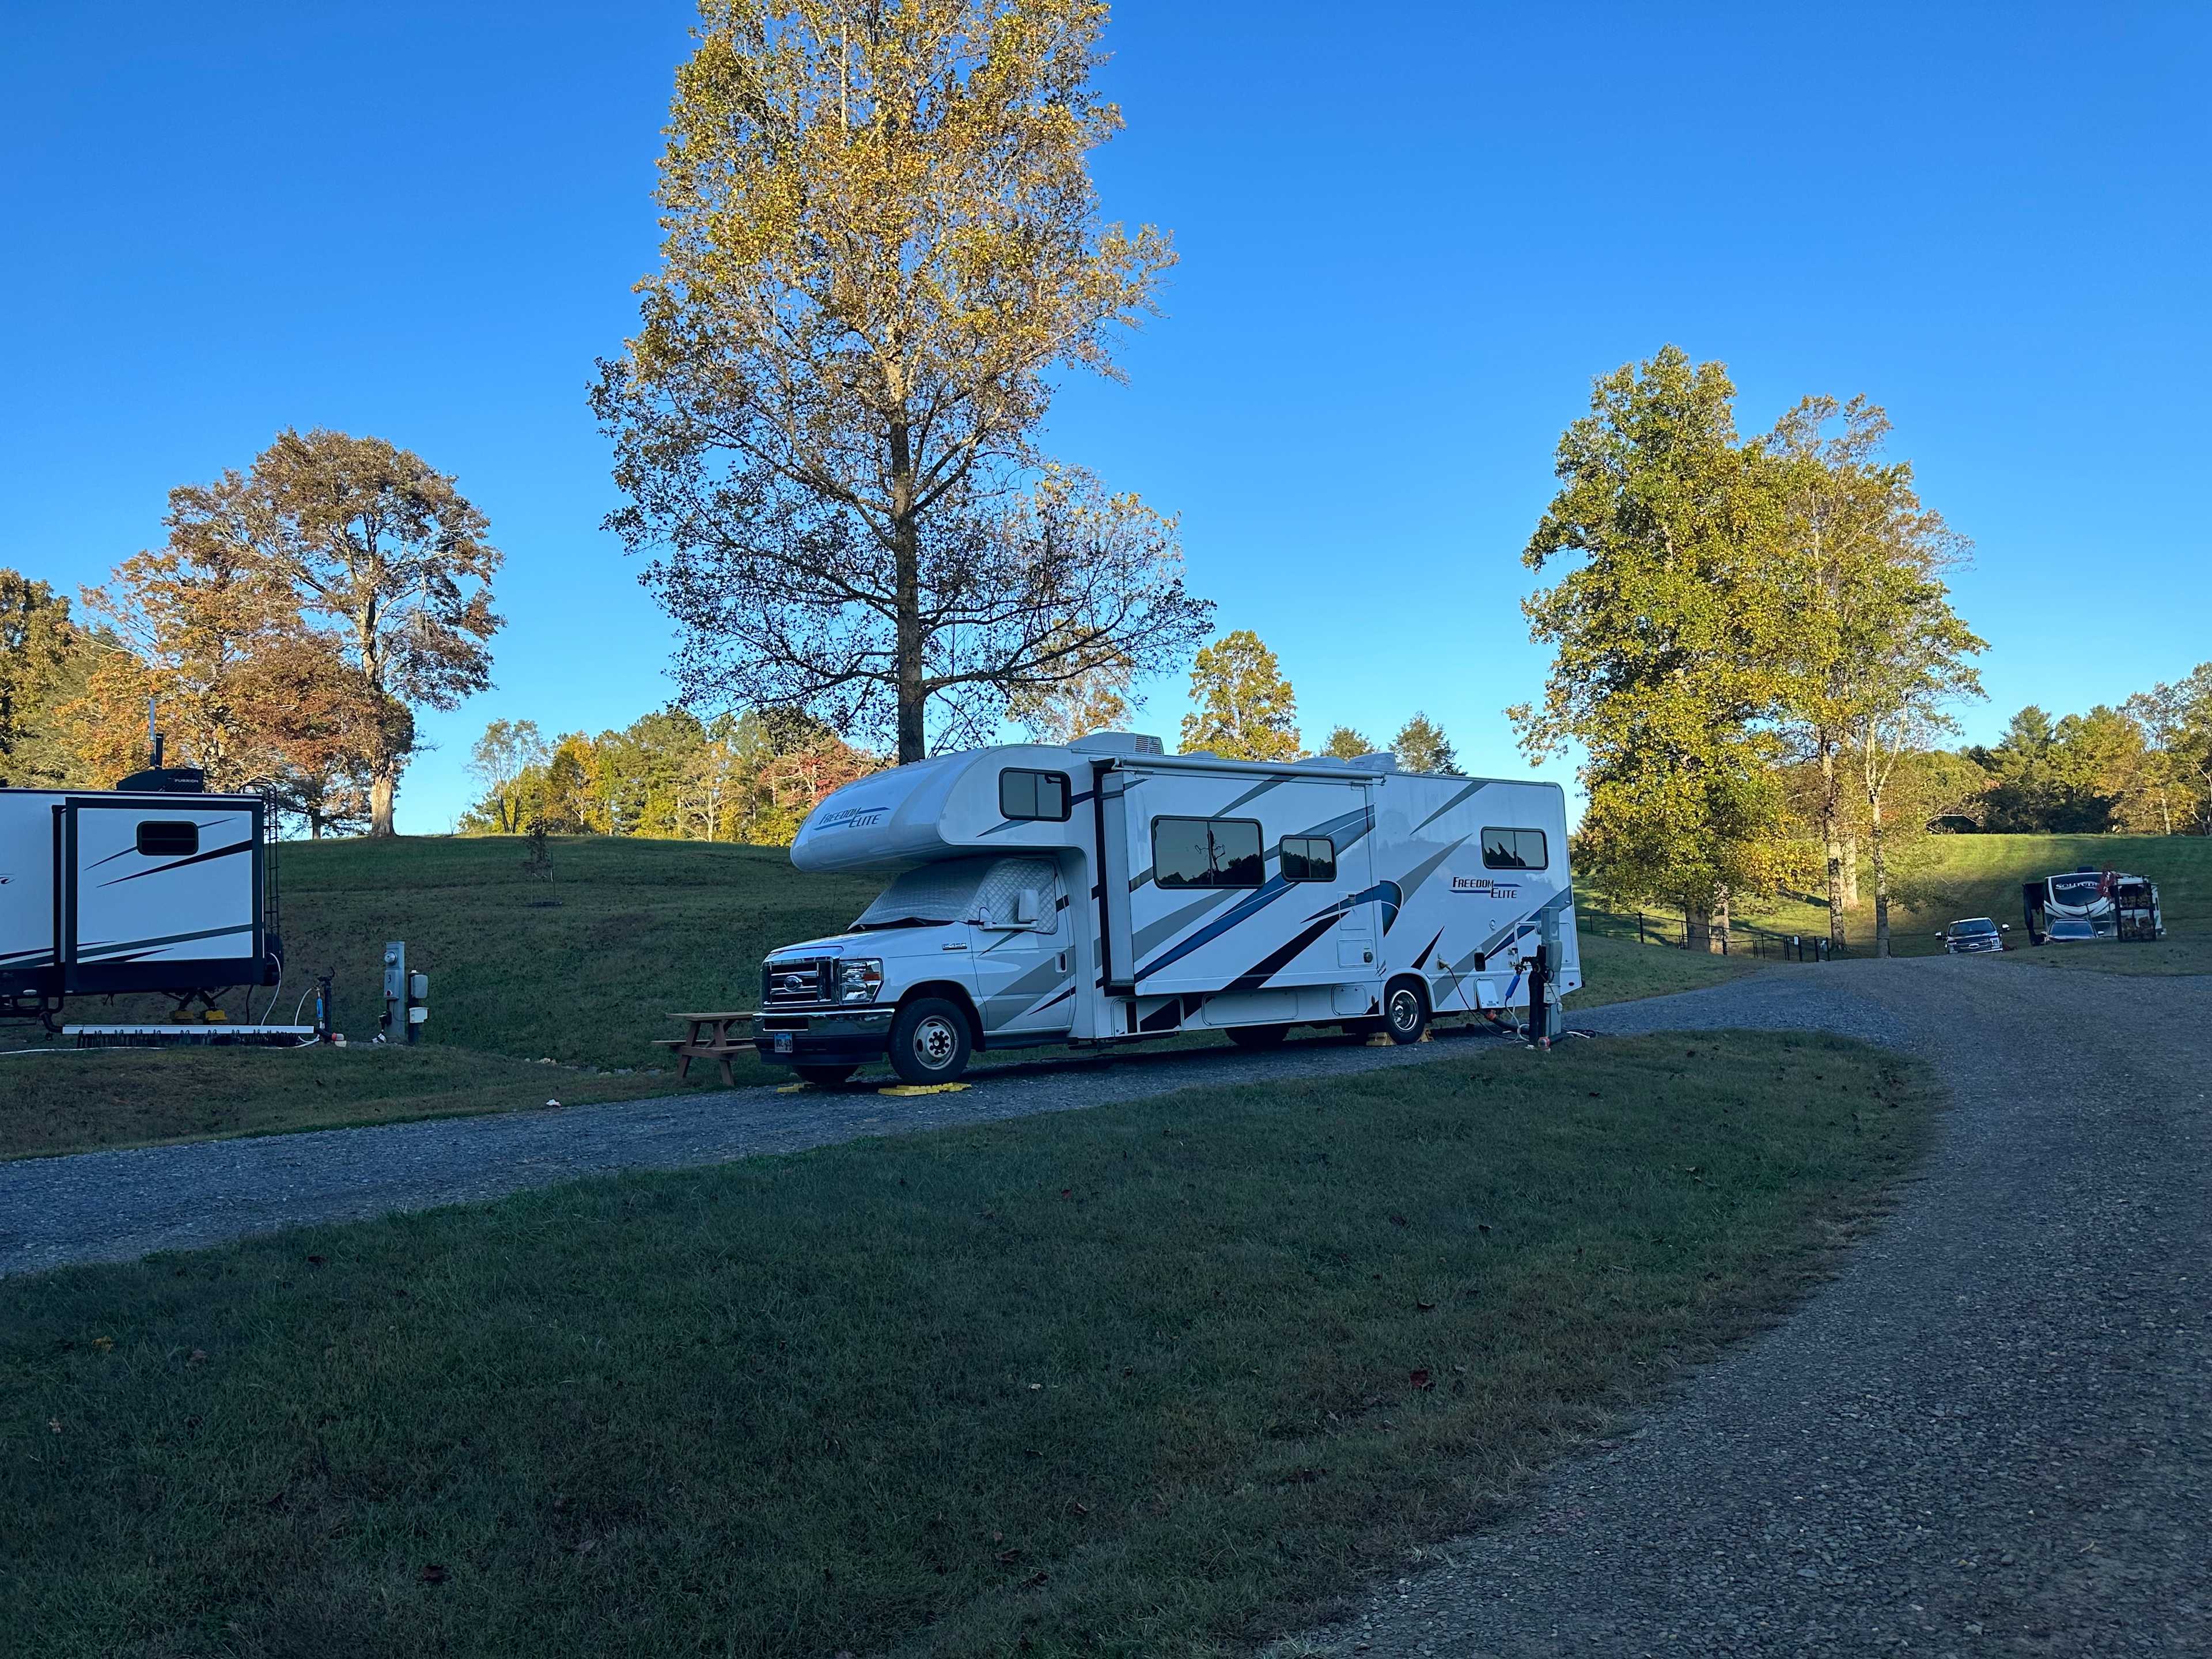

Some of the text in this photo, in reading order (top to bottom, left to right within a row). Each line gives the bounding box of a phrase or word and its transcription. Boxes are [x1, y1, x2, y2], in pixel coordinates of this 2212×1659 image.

[819, 806, 862, 825] FREEDOM
[849, 813, 882, 828] ELITE
[1452, 876, 1494, 888] FREEDOM
[1490, 887, 1517, 899] ELITE
[387, 974, 392, 983] 3
